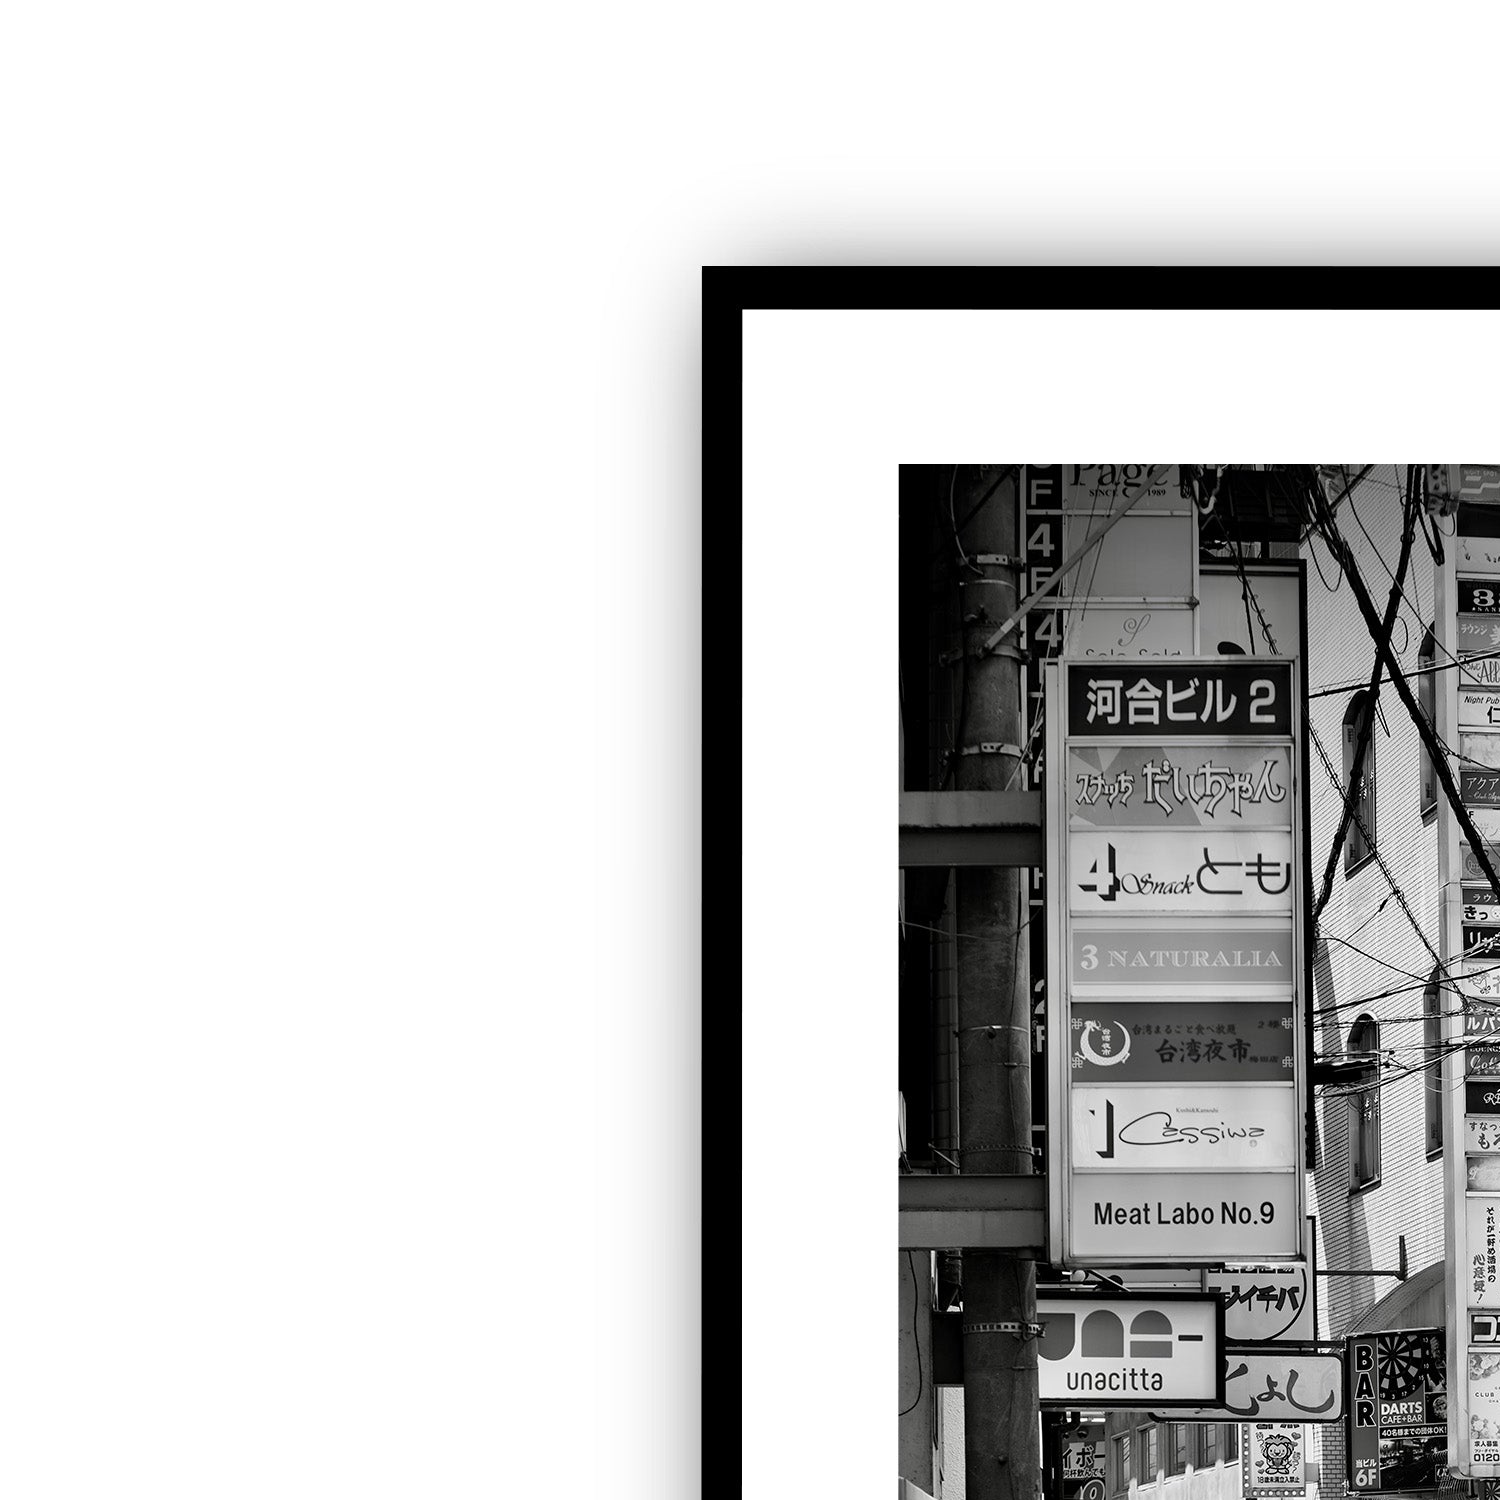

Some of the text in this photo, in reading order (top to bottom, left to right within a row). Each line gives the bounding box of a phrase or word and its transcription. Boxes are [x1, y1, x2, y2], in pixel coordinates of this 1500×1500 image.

[1089, 488, 1166, 497] SINCE 1989
[1460, 623, 1488, 636] ラウンジ
[1086, 677, 1276, 725] 河合ビル 2
[1486, 696, 1500, 705] Pub
[1121, 847, 1291, 895] Snack とも
[1080, 944, 1283, 971] 3 NATURALIA
[1155, 1037, 1251, 1064] 台湾夜市
[1094, 1201, 1275, 1226] Meat Labo No.9
[1066, 1368, 1164, 1392] unacitta
[1354, 1344, 1377, 1428] BAR
[1380, 1401, 1423, 1416] DARTS
[1355, 1468, 1377, 1487] 6F
